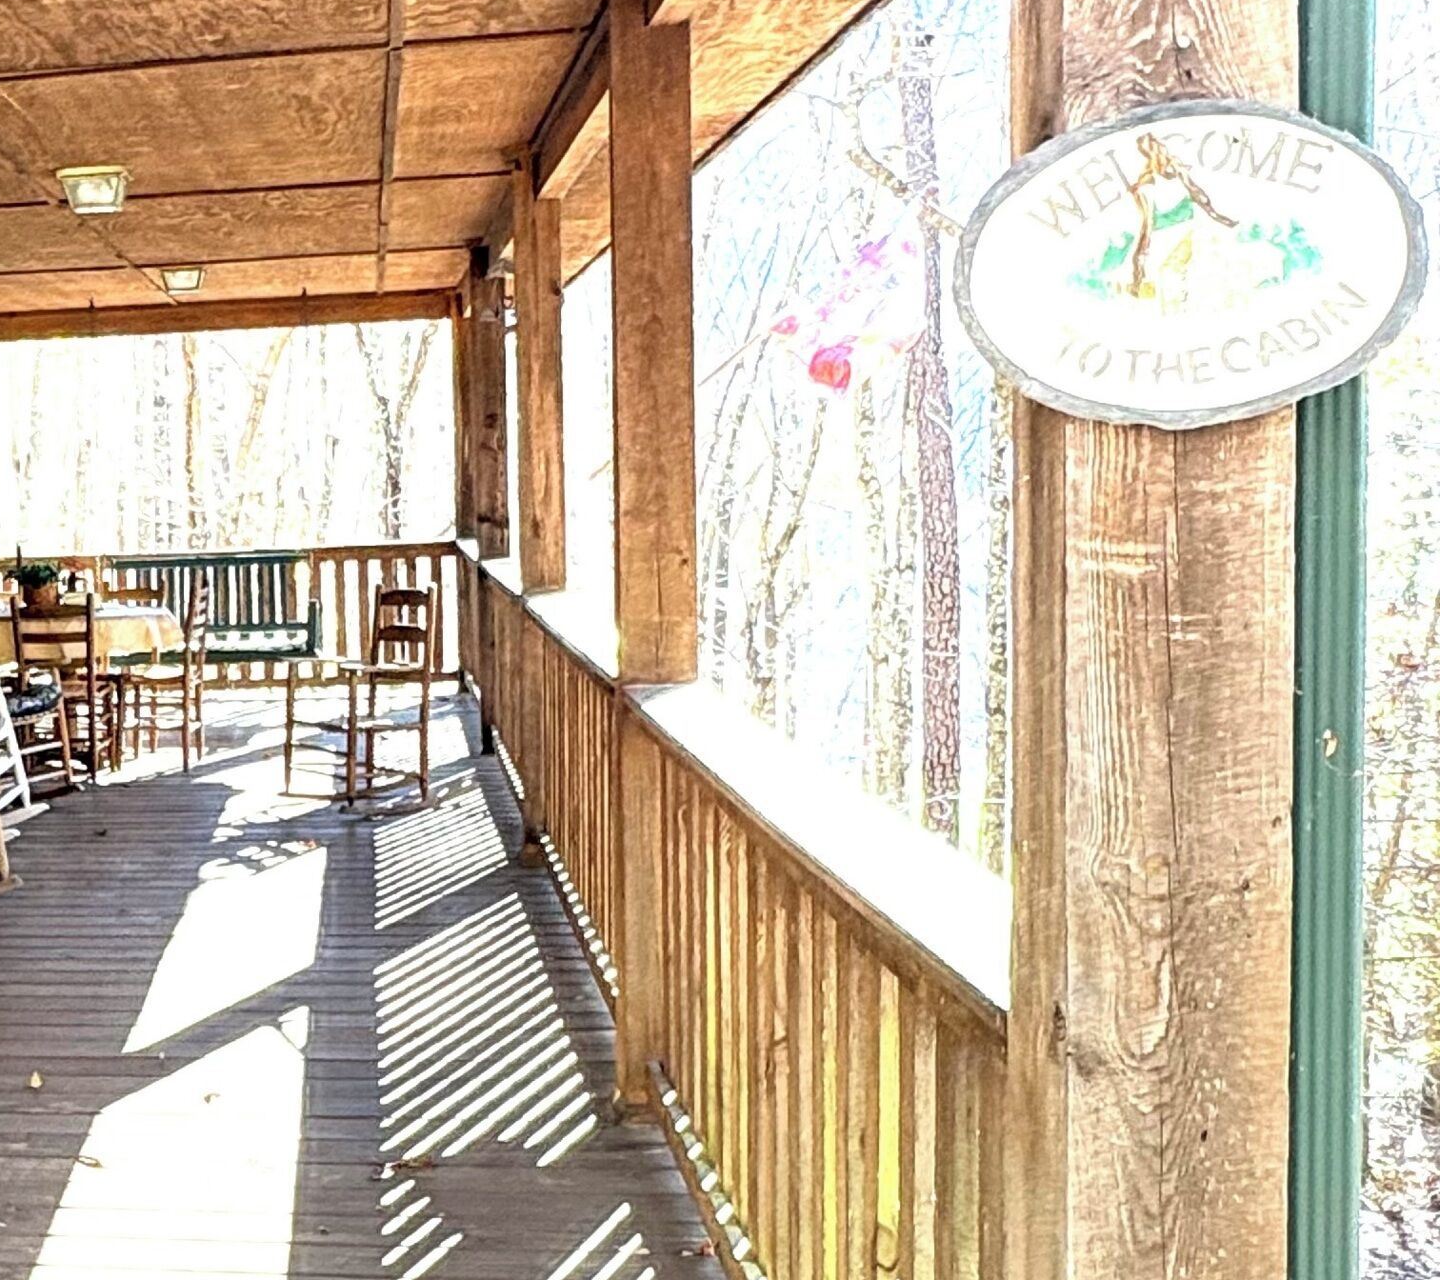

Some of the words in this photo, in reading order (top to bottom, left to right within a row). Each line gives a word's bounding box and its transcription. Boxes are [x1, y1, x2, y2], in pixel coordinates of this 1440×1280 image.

[1025, 127, 1335, 239] WELCOME
[1056, 322, 1113, 380] TO
[1124, 346, 1215, 385] THE
[1219, 280, 1370, 375] CABIN
